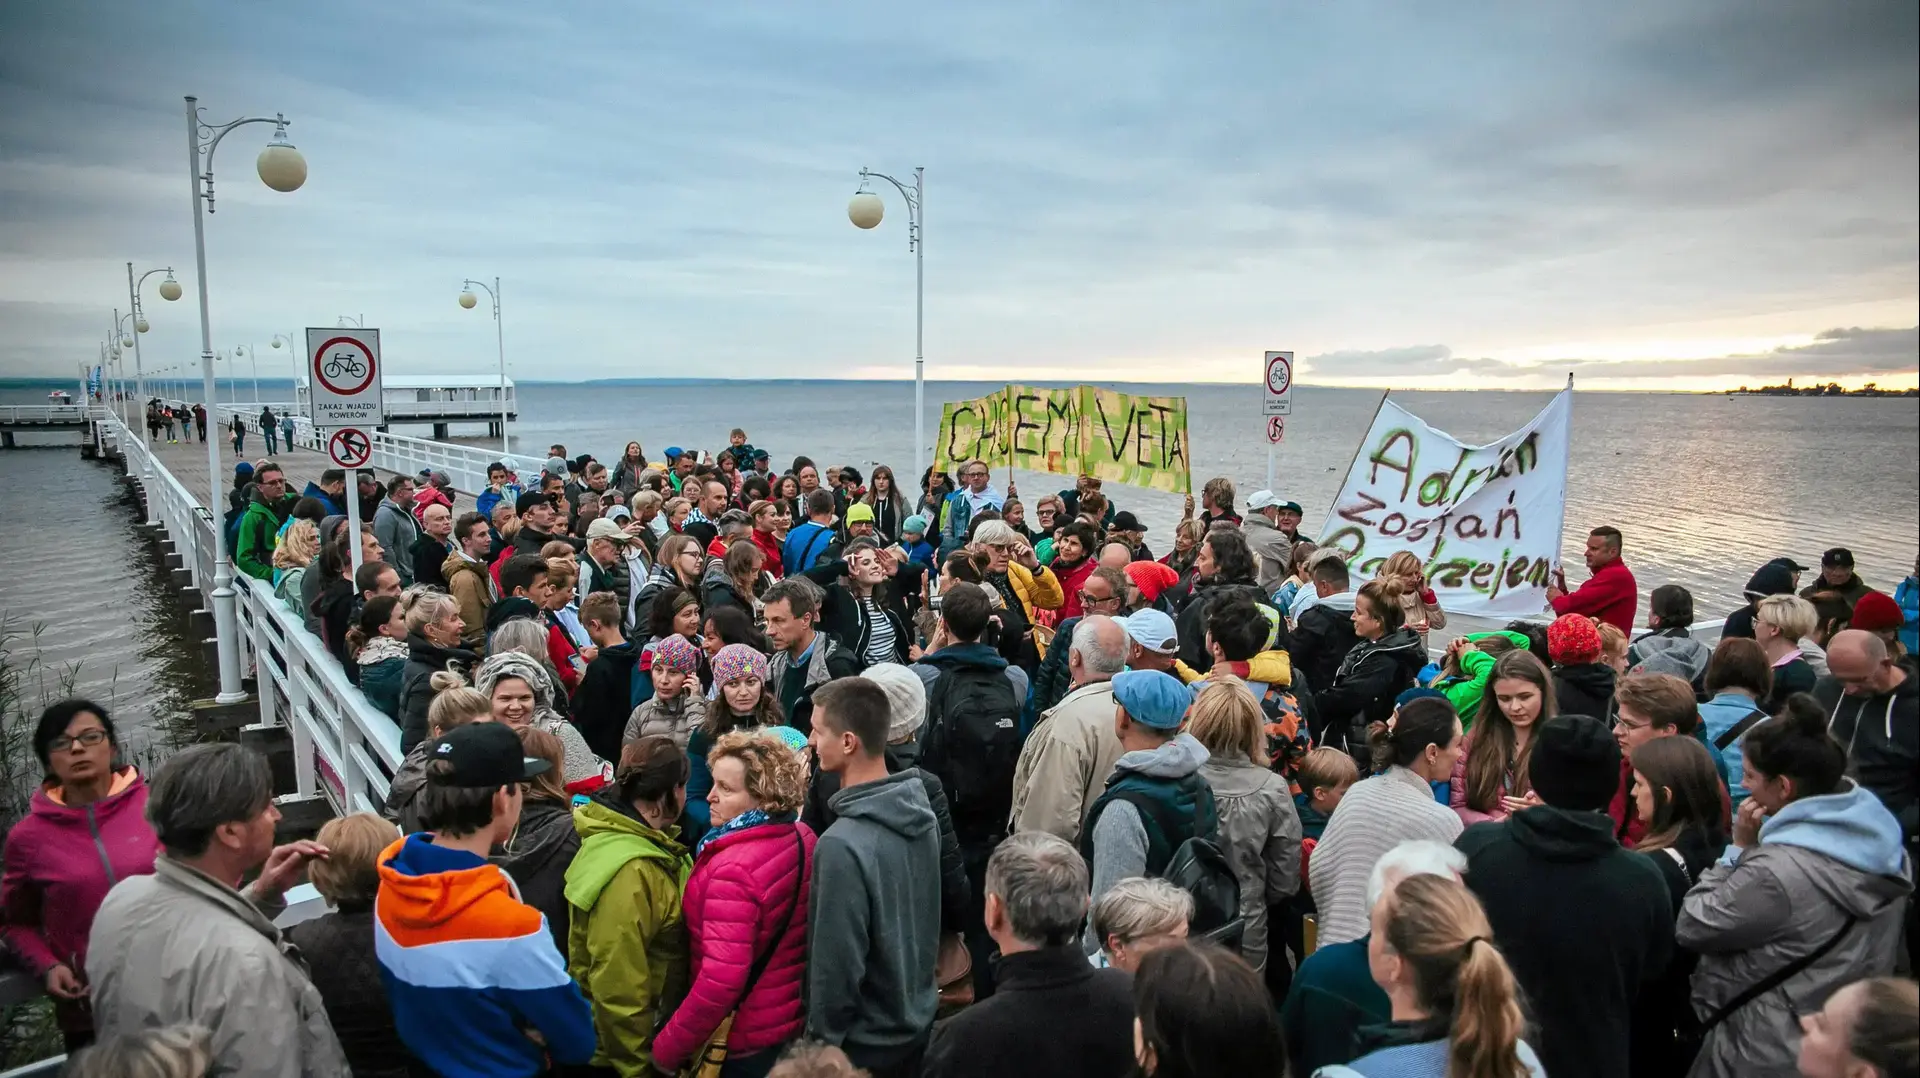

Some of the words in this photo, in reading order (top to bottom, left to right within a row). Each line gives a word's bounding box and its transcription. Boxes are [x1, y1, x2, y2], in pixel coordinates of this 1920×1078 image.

[317, 403, 343, 411] ZAKAZ
[346, 402, 377, 410] WJAZDU
[328, 411, 368, 419] ROWERÓW
[1095, 394, 1185, 471] VETA
